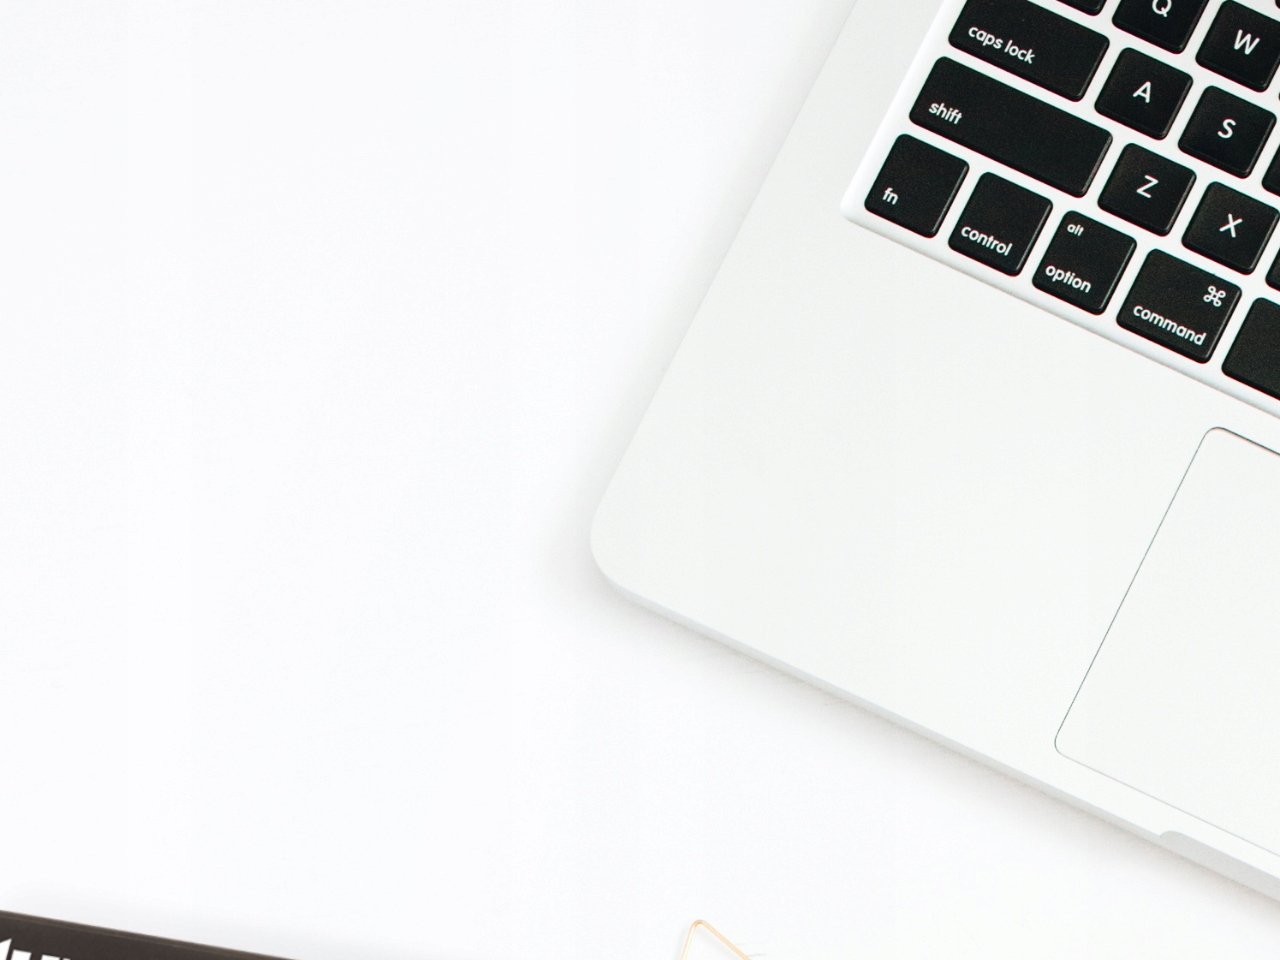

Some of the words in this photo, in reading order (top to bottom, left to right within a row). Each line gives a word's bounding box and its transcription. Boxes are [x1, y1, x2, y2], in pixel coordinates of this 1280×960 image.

[1151, 0, 1172, 18] Q
[968, 26, 1004, 49] caps
[1004, 39, 1036, 64] lock
[1233, 29, 1260, 55] W
[1132, 81, 1152, 104] A
[928, 102, 962, 125] shift
[1217, 118, 1237, 139] S
[882, 187, 899, 205] fn
[1136, 174, 1159, 199] Z
[1066, 223, 1084, 237] alt
[1219, 213, 1243, 238] X
[960, 226, 1013, 256] control
[1045, 265, 1092, 293] option
[1133, 305, 1207, 346] command
